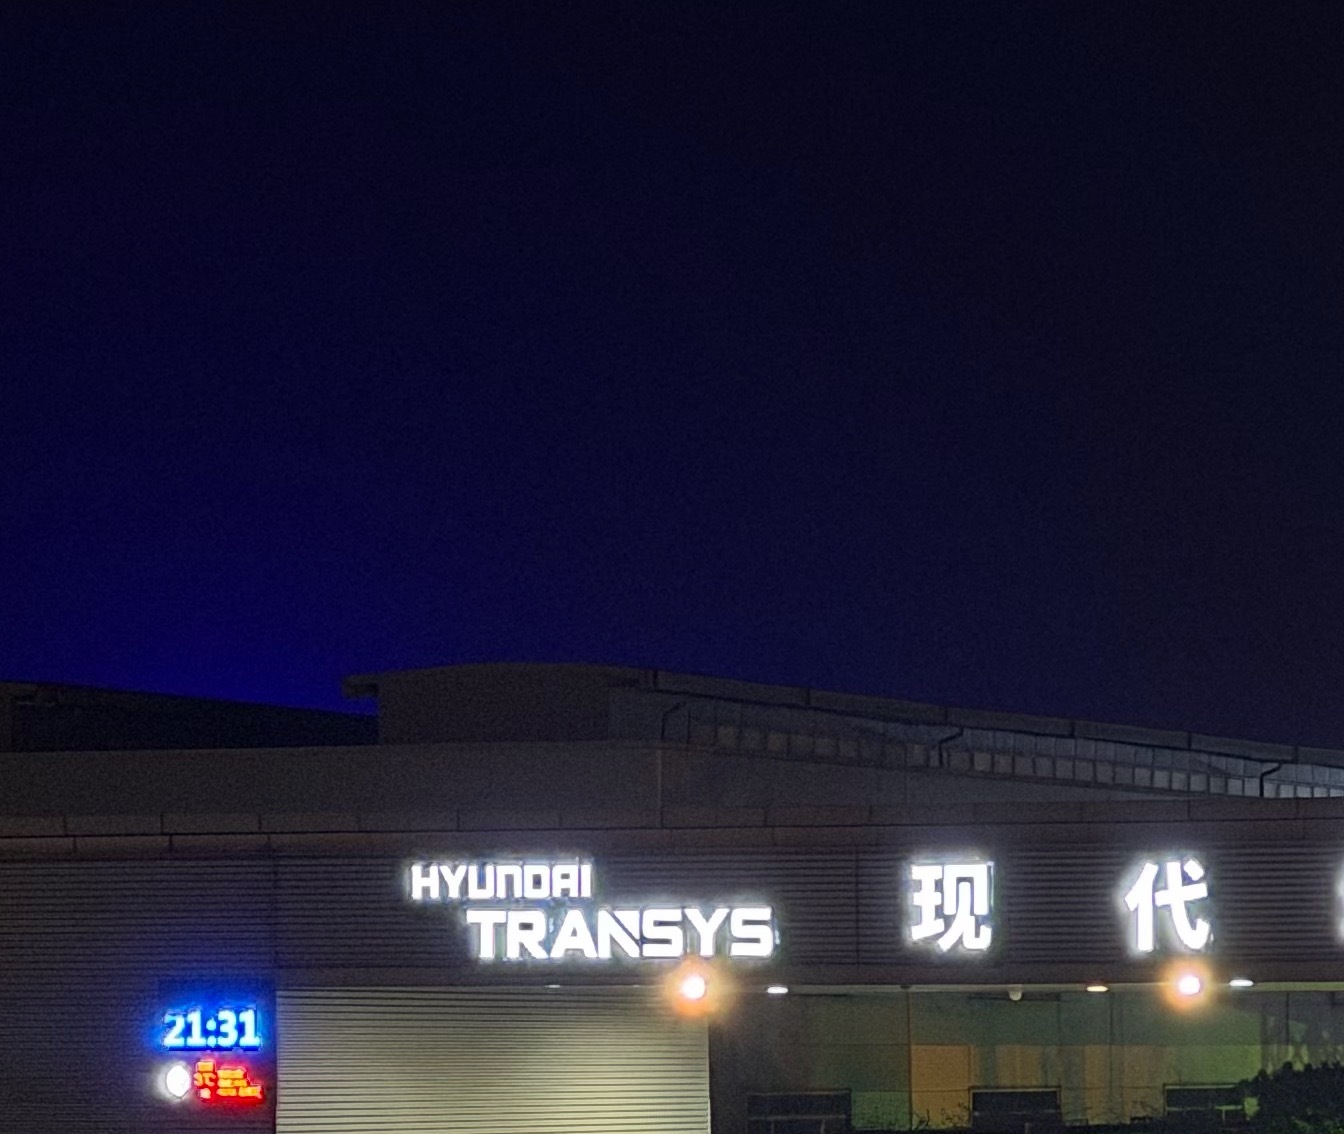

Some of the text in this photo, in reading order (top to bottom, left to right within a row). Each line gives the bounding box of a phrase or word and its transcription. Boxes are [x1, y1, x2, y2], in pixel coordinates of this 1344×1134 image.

[410, 862, 593, 900] HYUNDAI
[465, 906, 774, 959] TRANSYS
[163, 1008, 262, 1048] 21:31
